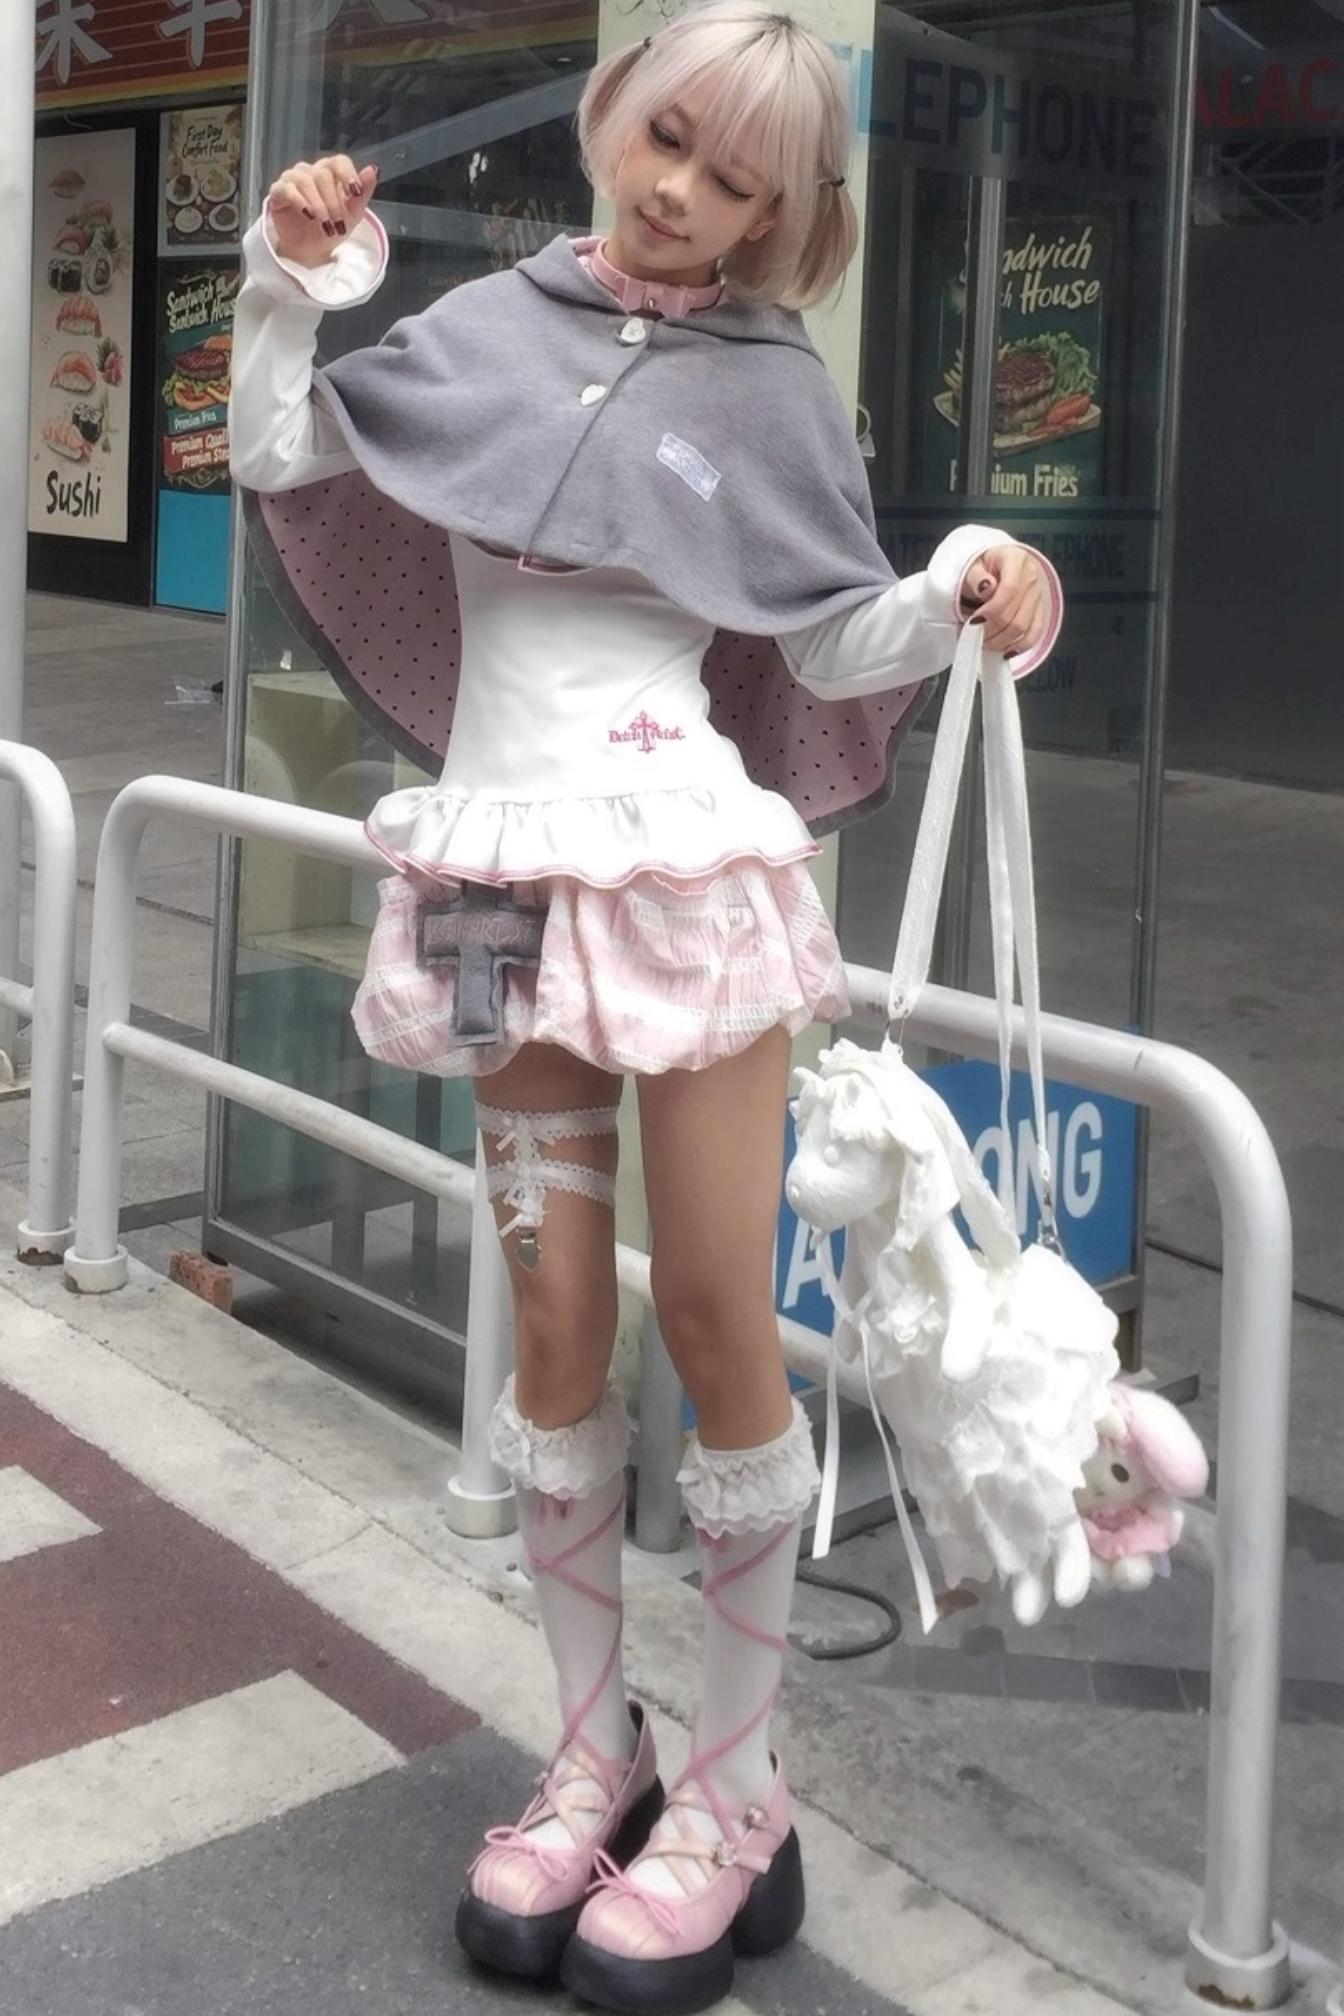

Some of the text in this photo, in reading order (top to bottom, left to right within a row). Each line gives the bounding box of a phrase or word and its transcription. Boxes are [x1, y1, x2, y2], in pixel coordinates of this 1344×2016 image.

[1019, 270, 1101, 315] House
[46, 469, 102, 518] Sushi
[1033, 463, 1079, 497] Fries
